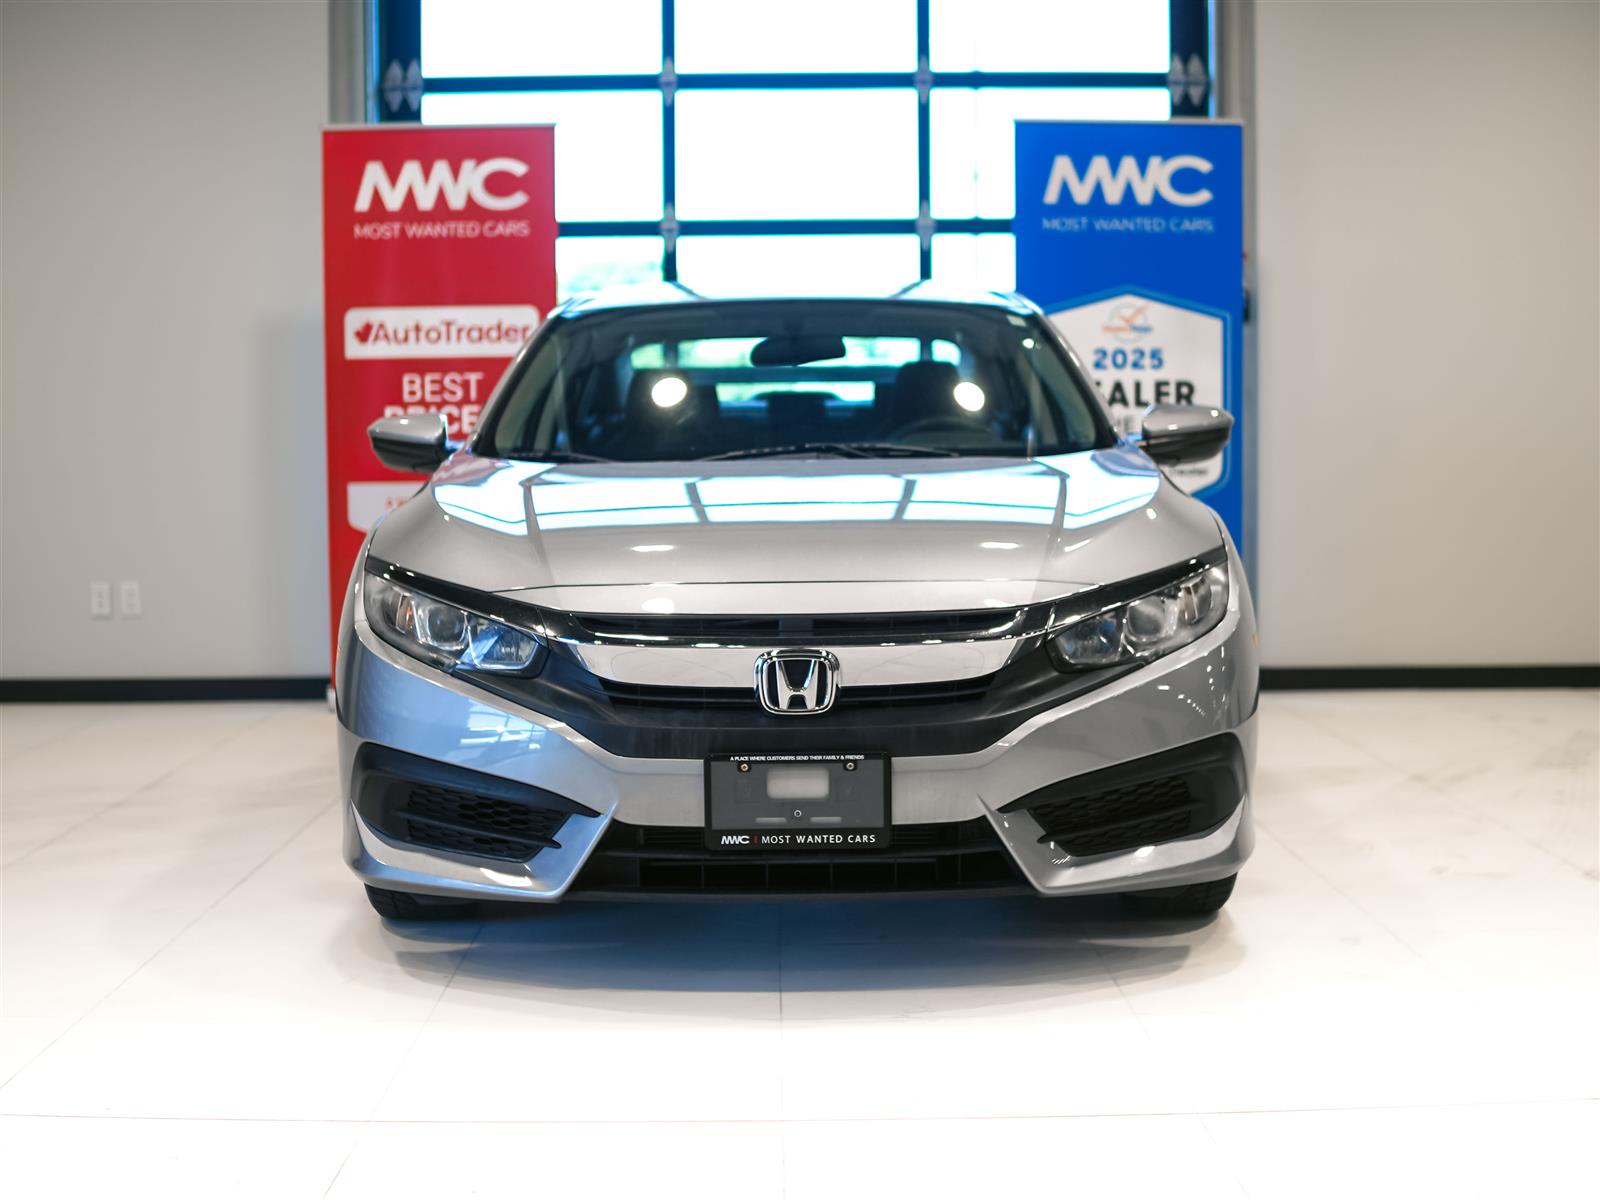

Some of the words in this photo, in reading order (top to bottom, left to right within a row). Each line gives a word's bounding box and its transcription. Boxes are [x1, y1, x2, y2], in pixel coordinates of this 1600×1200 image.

[353, 157, 530, 212] MWC
[1042, 154, 1214, 207] MWC
[353, 222, 401, 240] MOST
[404, 221, 481, 239] WANTED
[482, 220, 530, 238] CARS
[1041, 216, 1088, 232] MOST
[1093, 216, 1166, 232] WANTED
[1169, 216, 1214, 232] CARS
[372, 319, 531, 345] AutoTrader
[1093, 347, 1165, 370] 2025
[402, 372, 485, 402] BEST
[1094, 379, 1196, 408] ALER
[761, 835, 791, 844] MOST
[796, 835, 843, 844] WANTED
[847, 834, 876, 843] CARS
